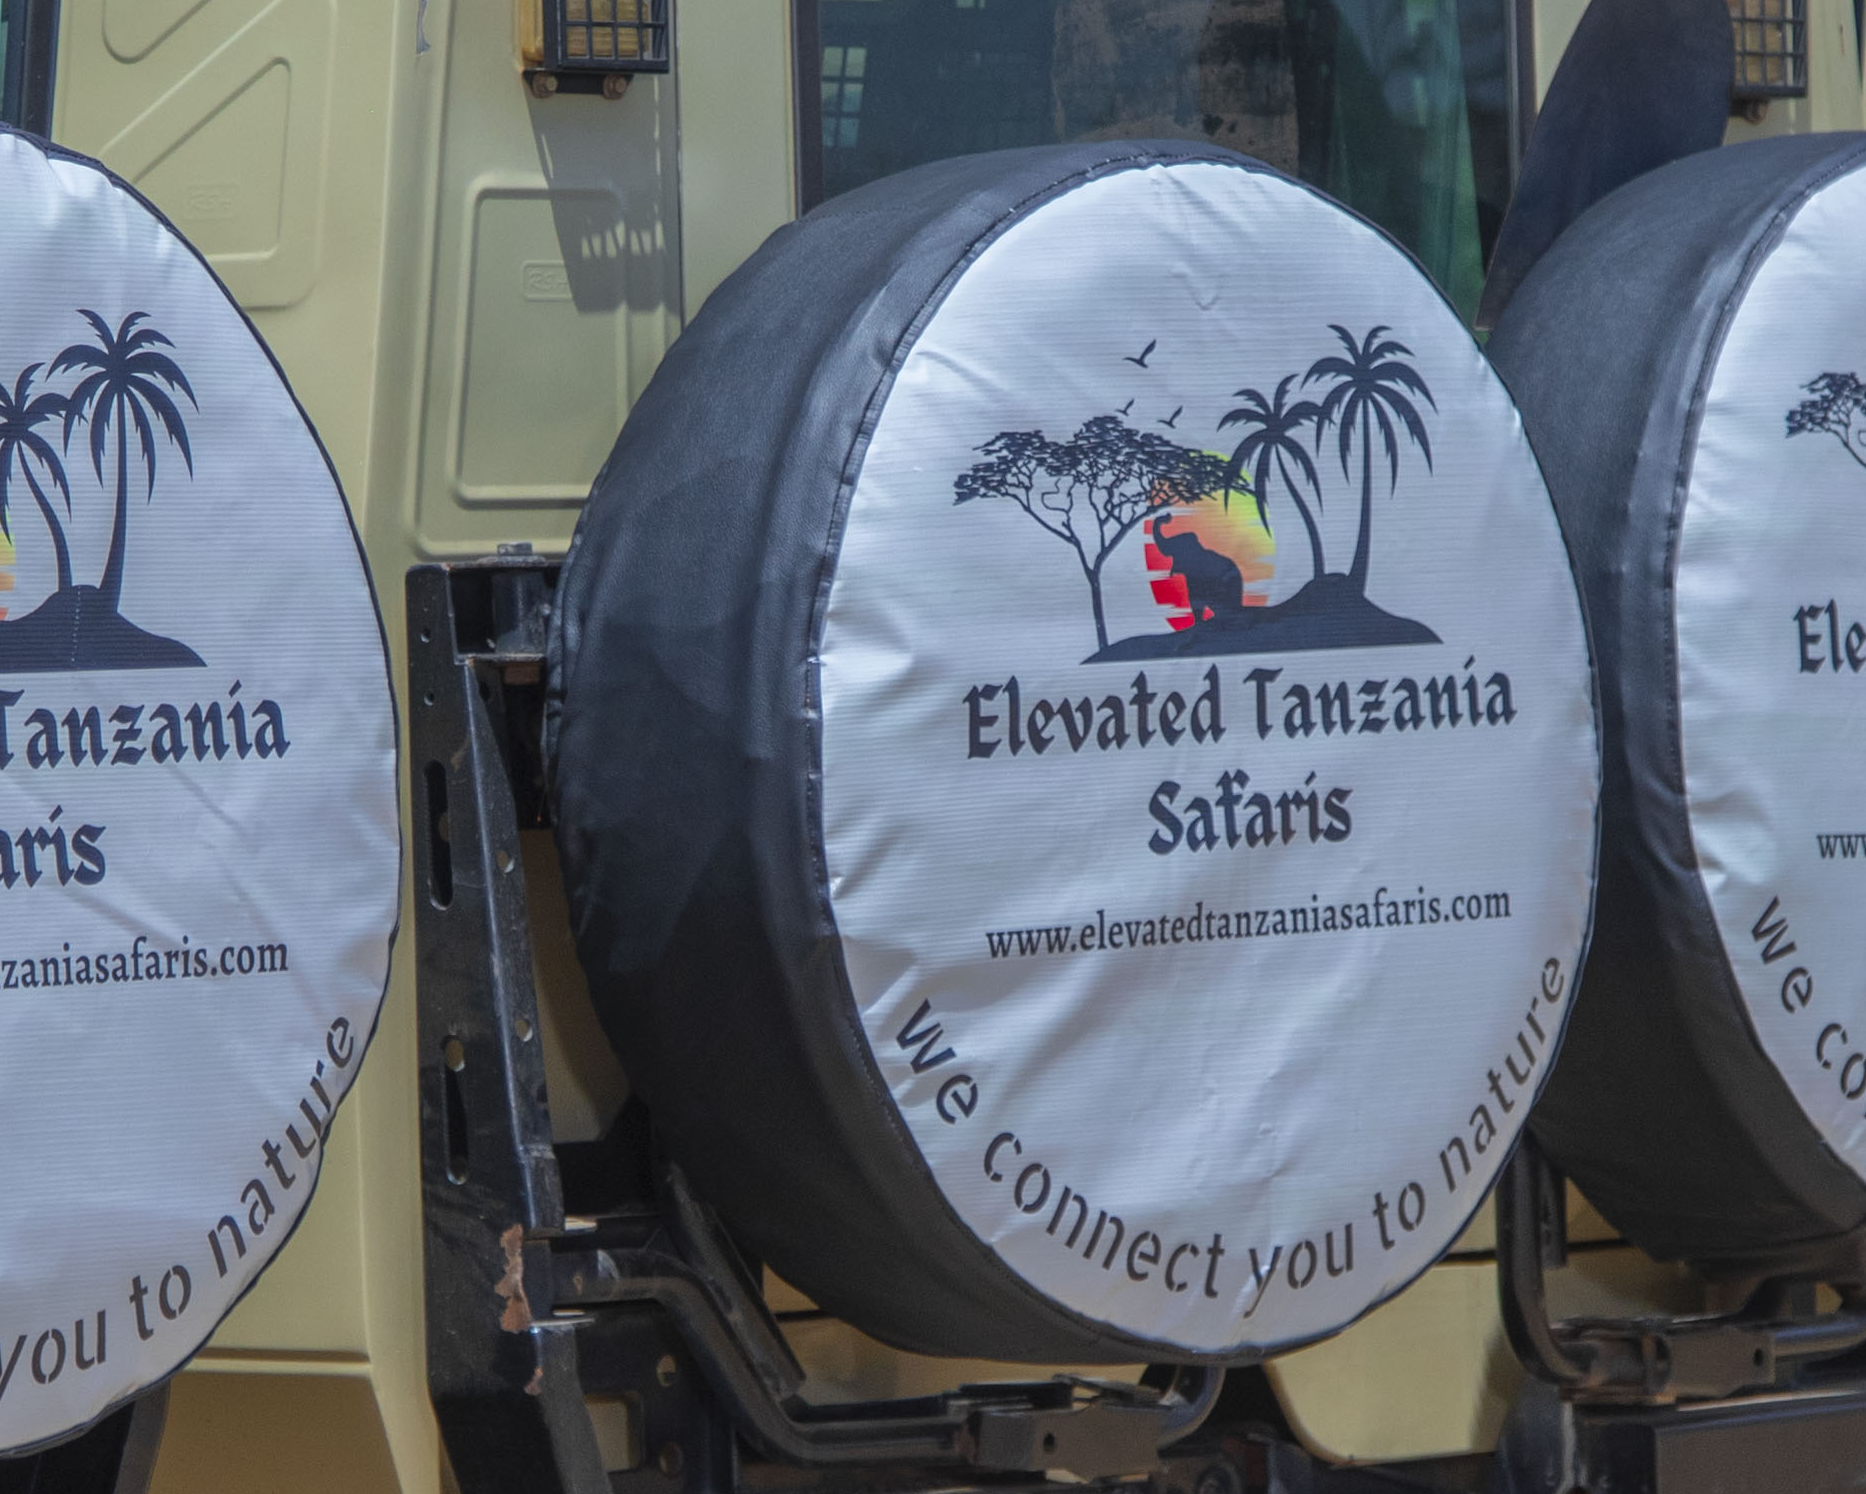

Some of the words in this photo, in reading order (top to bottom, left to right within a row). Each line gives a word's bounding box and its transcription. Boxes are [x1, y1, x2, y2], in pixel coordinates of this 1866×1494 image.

[963, 663, 1226, 759] Elevated
[985, 887, 1512, 959] www.elevatedtanzaniasafaris.com
[1751, 896, 1813, 1013] We
[128, 1264, 192, 1341] to
[207, 1015, 355, 1278] nature
[896, 999, 979, 1125] We
[983, 1131, 1224, 1299] connect
[1243, 1221, 1356, 1319] you
[1372, 1180, 1425, 1251] to
[1438, 956, 1564, 1193] nature
